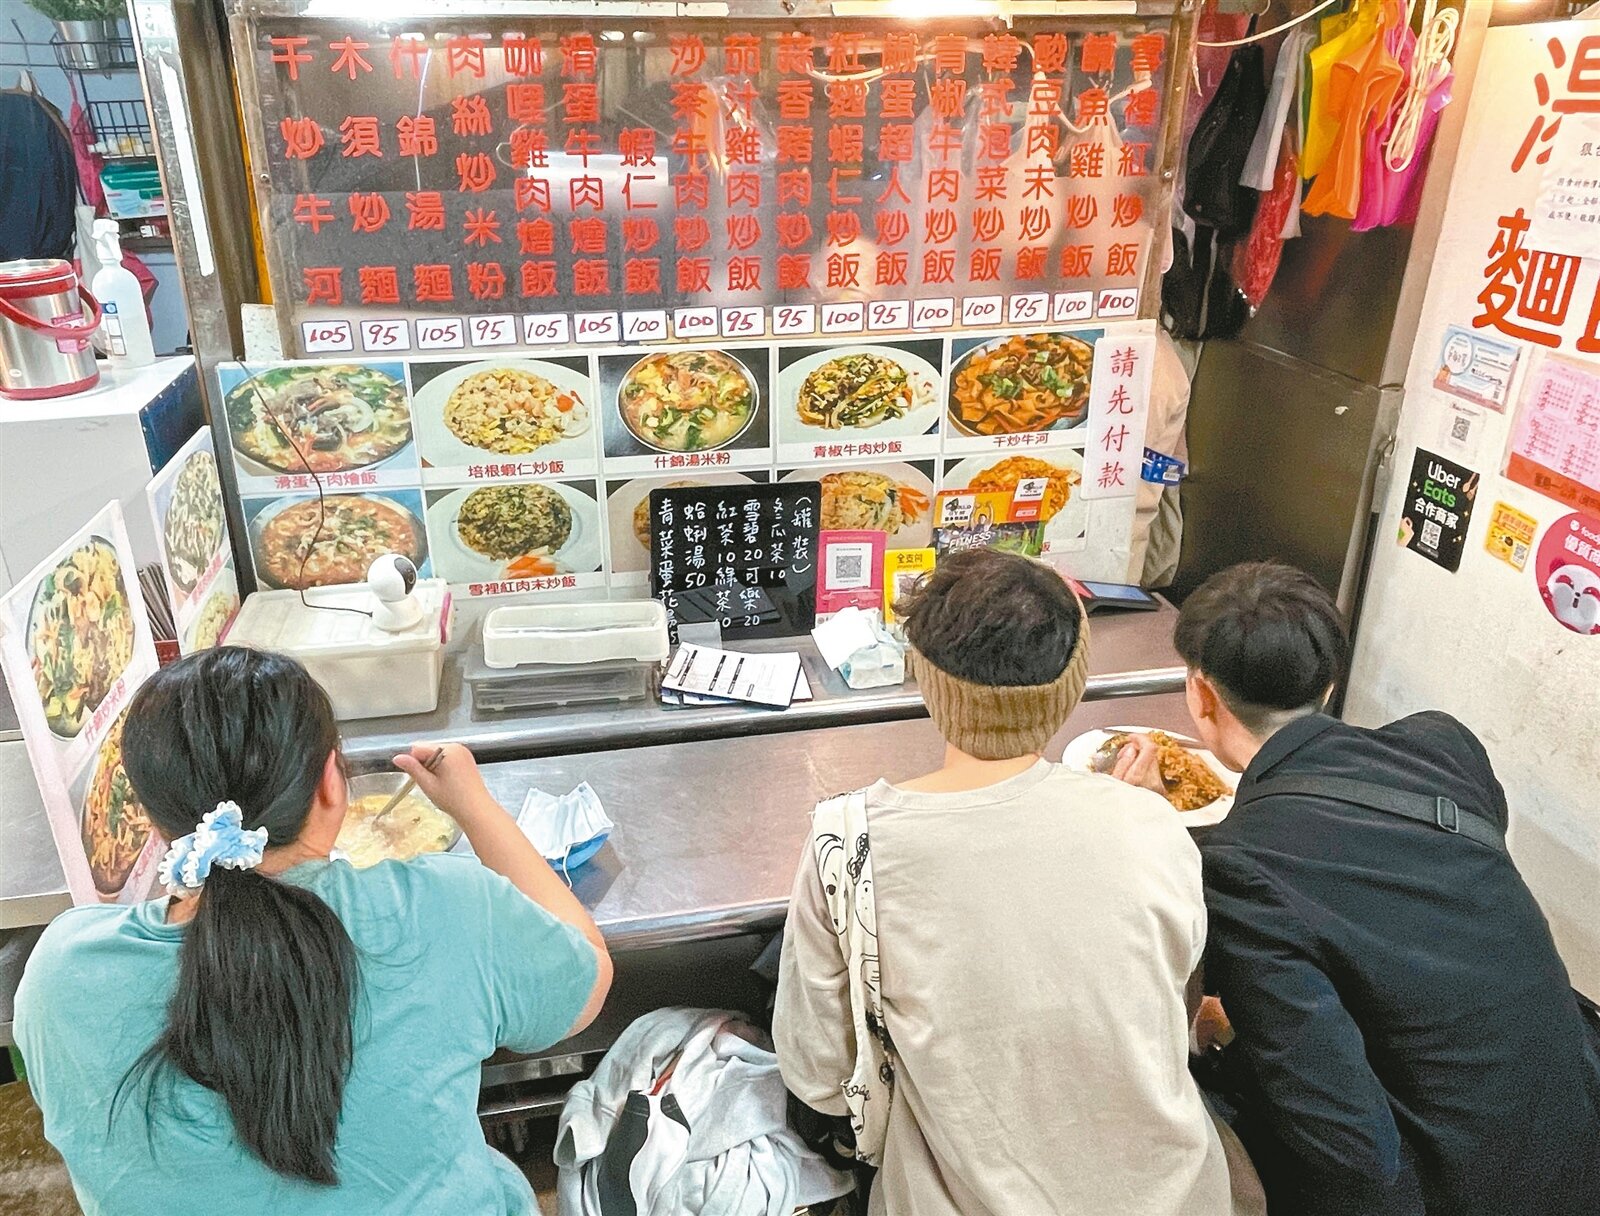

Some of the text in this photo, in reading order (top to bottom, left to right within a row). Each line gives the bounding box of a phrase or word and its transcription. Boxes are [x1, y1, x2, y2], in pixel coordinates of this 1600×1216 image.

[446, 36, 506, 299] 肉絲炒米粉
[560, 34, 611, 297] 滑蛋牛肉燴飯
[669, 34, 713, 294] 沙茶牛肉炒飯
[723, 34, 762, 292] 茄汁雞肉炒飯
[776, 33, 814, 291] 蒜香豬肉炒飯
[921, 33, 968, 284] 青椒牛肉炒飯
[969, 33, 1020, 282] 韓式泡菜炒飯
[271, 36, 343, 305] 干炒牛河
[329, 36, 399, 304] 木須炒麵
[388, 36, 454, 302] 什錦湯麵
[618, 127, 661, 296] 蝦仁炒飯
[965, 302, 995, 317] 100
[1014, 299, 1042, 319] 95
[1057, 300, 1087, 315] 100
[1100, 294, 1135, 310] 100
[678, 315, 714, 328] 100
[726, 309, 756, 331] 95
[776, 308, 804, 329] 95
[826, 310, 861, 327] 100
[873, 304, 901, 325] 95
[915, 307, 949, 322] 100
[309, 325, 348, 342] 105
[368, 325, 398, 345] 95
[422, 327, 460, 342] 105
[475, 320, 505, 341] 95
[527, 320, 559, 340] 105
[578, 316, 613, 334] 105
[628, 320, 660, 334] 100
[1097, 346, 1139, 489] 請先付款
[813, 440, 903, 458] 青椒牛肉炒飯
[992, 432, 1049, 448] 干炒牛河
[468, 461, 565, 479] 培根蝦仁炒飯
[654, 452, 731, 469] 什錦湯米粉
[274, 471, 378, 490] 滑蛋牛肉燴飯
[1428, 461, 1461, 489] Uber
[1423, 479, 1456, 508] Eats
[1414, 497, 1459, 530] 合作商家
[948, 531, 993, 549] FITNESS
